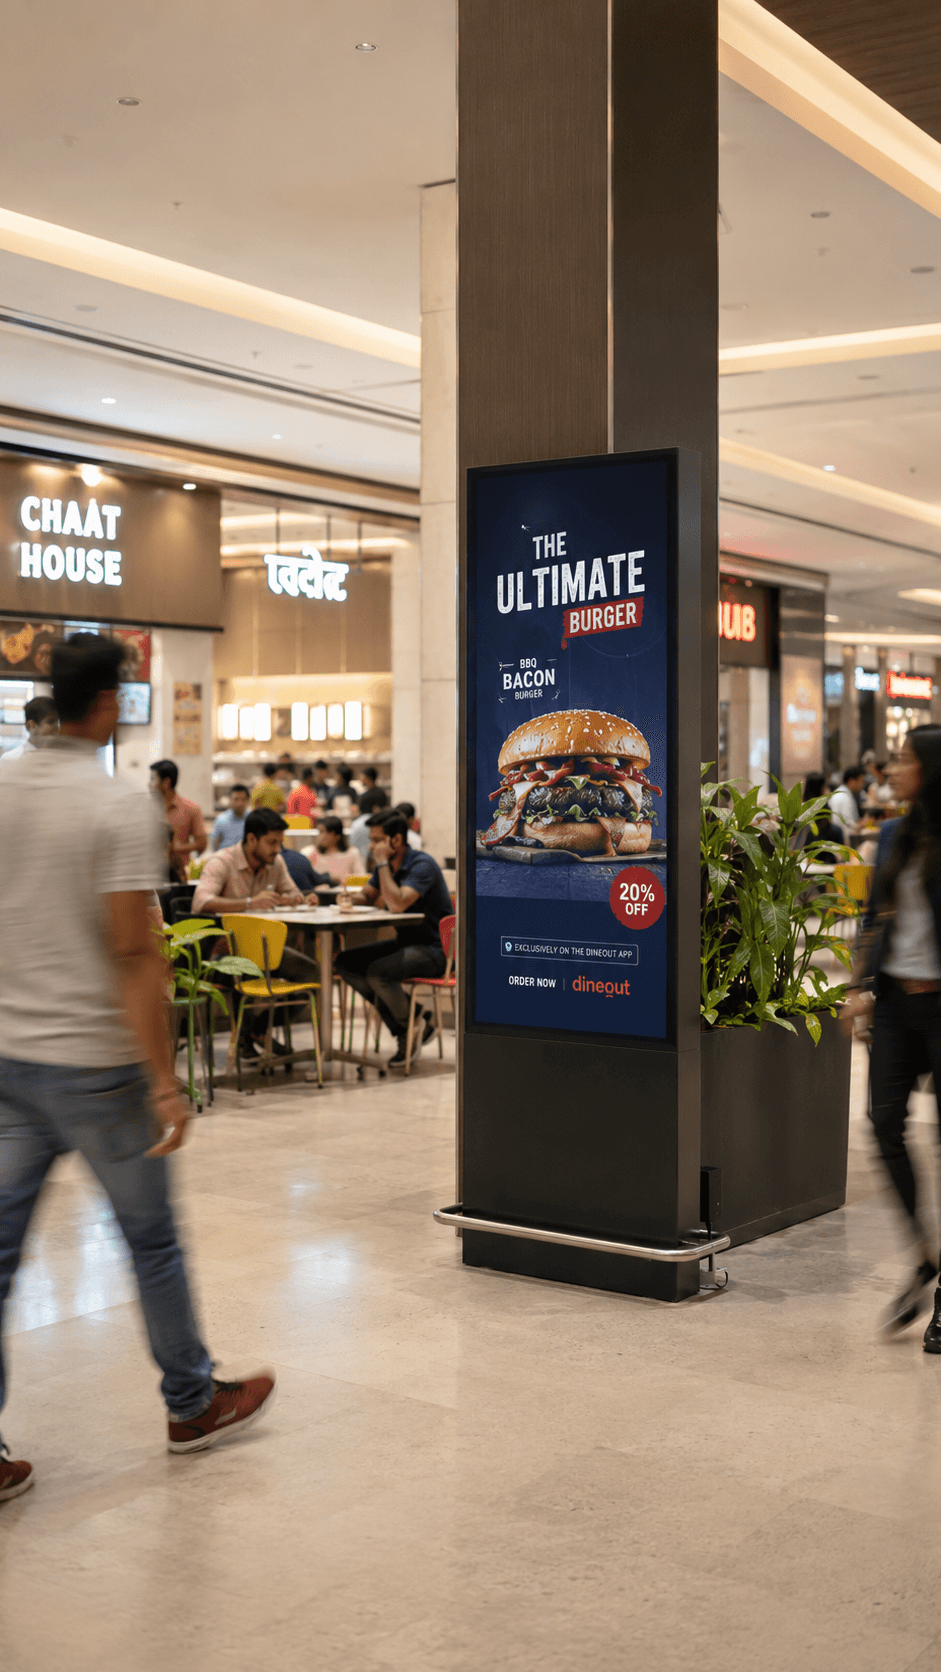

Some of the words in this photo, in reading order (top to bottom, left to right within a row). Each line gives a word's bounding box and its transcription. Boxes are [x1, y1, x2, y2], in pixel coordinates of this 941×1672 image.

[20, 495, 122, 541] CHAAT
[532, 531, 567, 560] THE
[20, 541, 122, 587] HOUSE
[496, 549, 646, 614] ULTIMATE
[569, 601, 637, 634] BURGER
[519, 657, 537, 669] BBQ
[502, 668, 556, 690] BACON
[514, 688, 544, 700] BURGER
[619, 882, 655, 902] 20%
[625, 902, 649, 916] OFF
[514, 943, 559, 954] EXCLUSIVELY
[559, 946, 570, 955] ON
[570, 947, 585, 956] THE
[585, 948, 617, 958] DINEOUT
[617, 950, 633, 959] APP
[508, 975, 535, 987] ORDER
[536, 977, 557, 988] NOW
[572, 975, 631, 998] dineout
